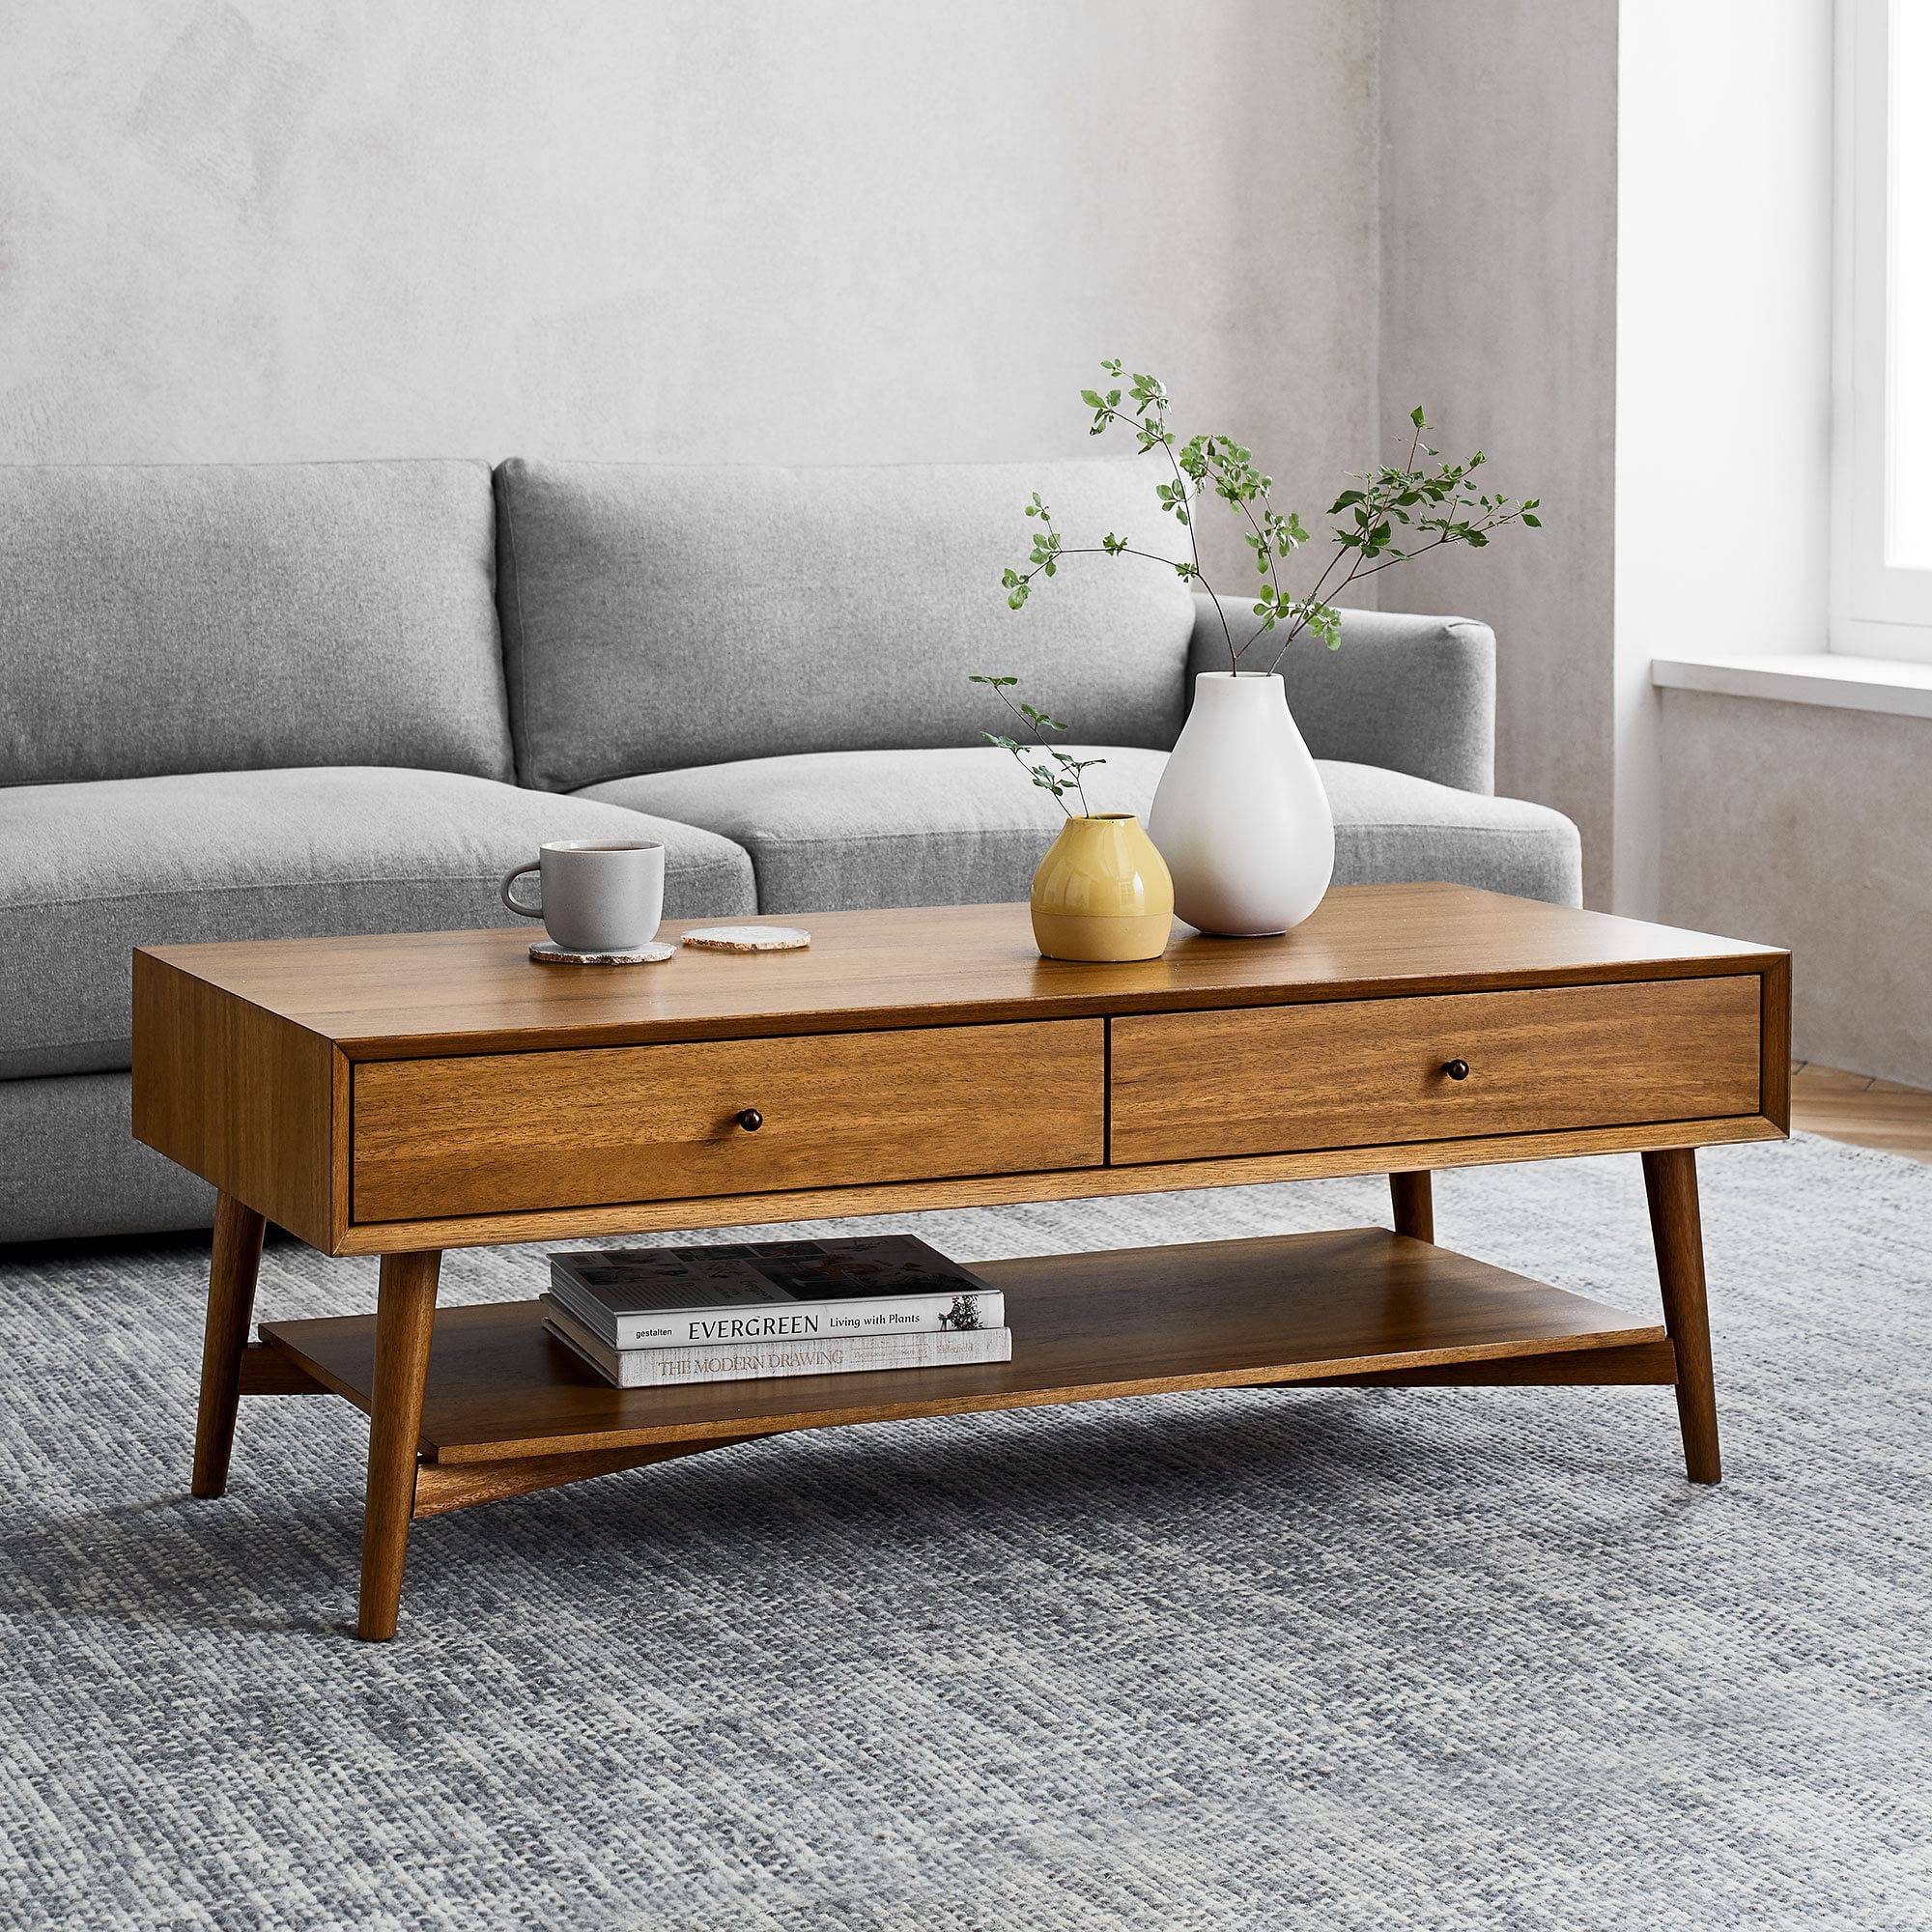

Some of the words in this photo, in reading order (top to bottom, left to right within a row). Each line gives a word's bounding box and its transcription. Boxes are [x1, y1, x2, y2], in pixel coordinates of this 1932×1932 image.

[689, 1315, 819, 1340] EVERGREEN
[830, 1317, 861, 1328] Living
[864, 1314, 887, 1325] with
[889, 1313, 921, 1324] Plants
[636, 1328, 672, 1339] gestalten
[659, 1359, 691, 1377] THE
[695, 1355, 765, 1375] MODERN
[768, 1350, 844, 1369] DRAWING
